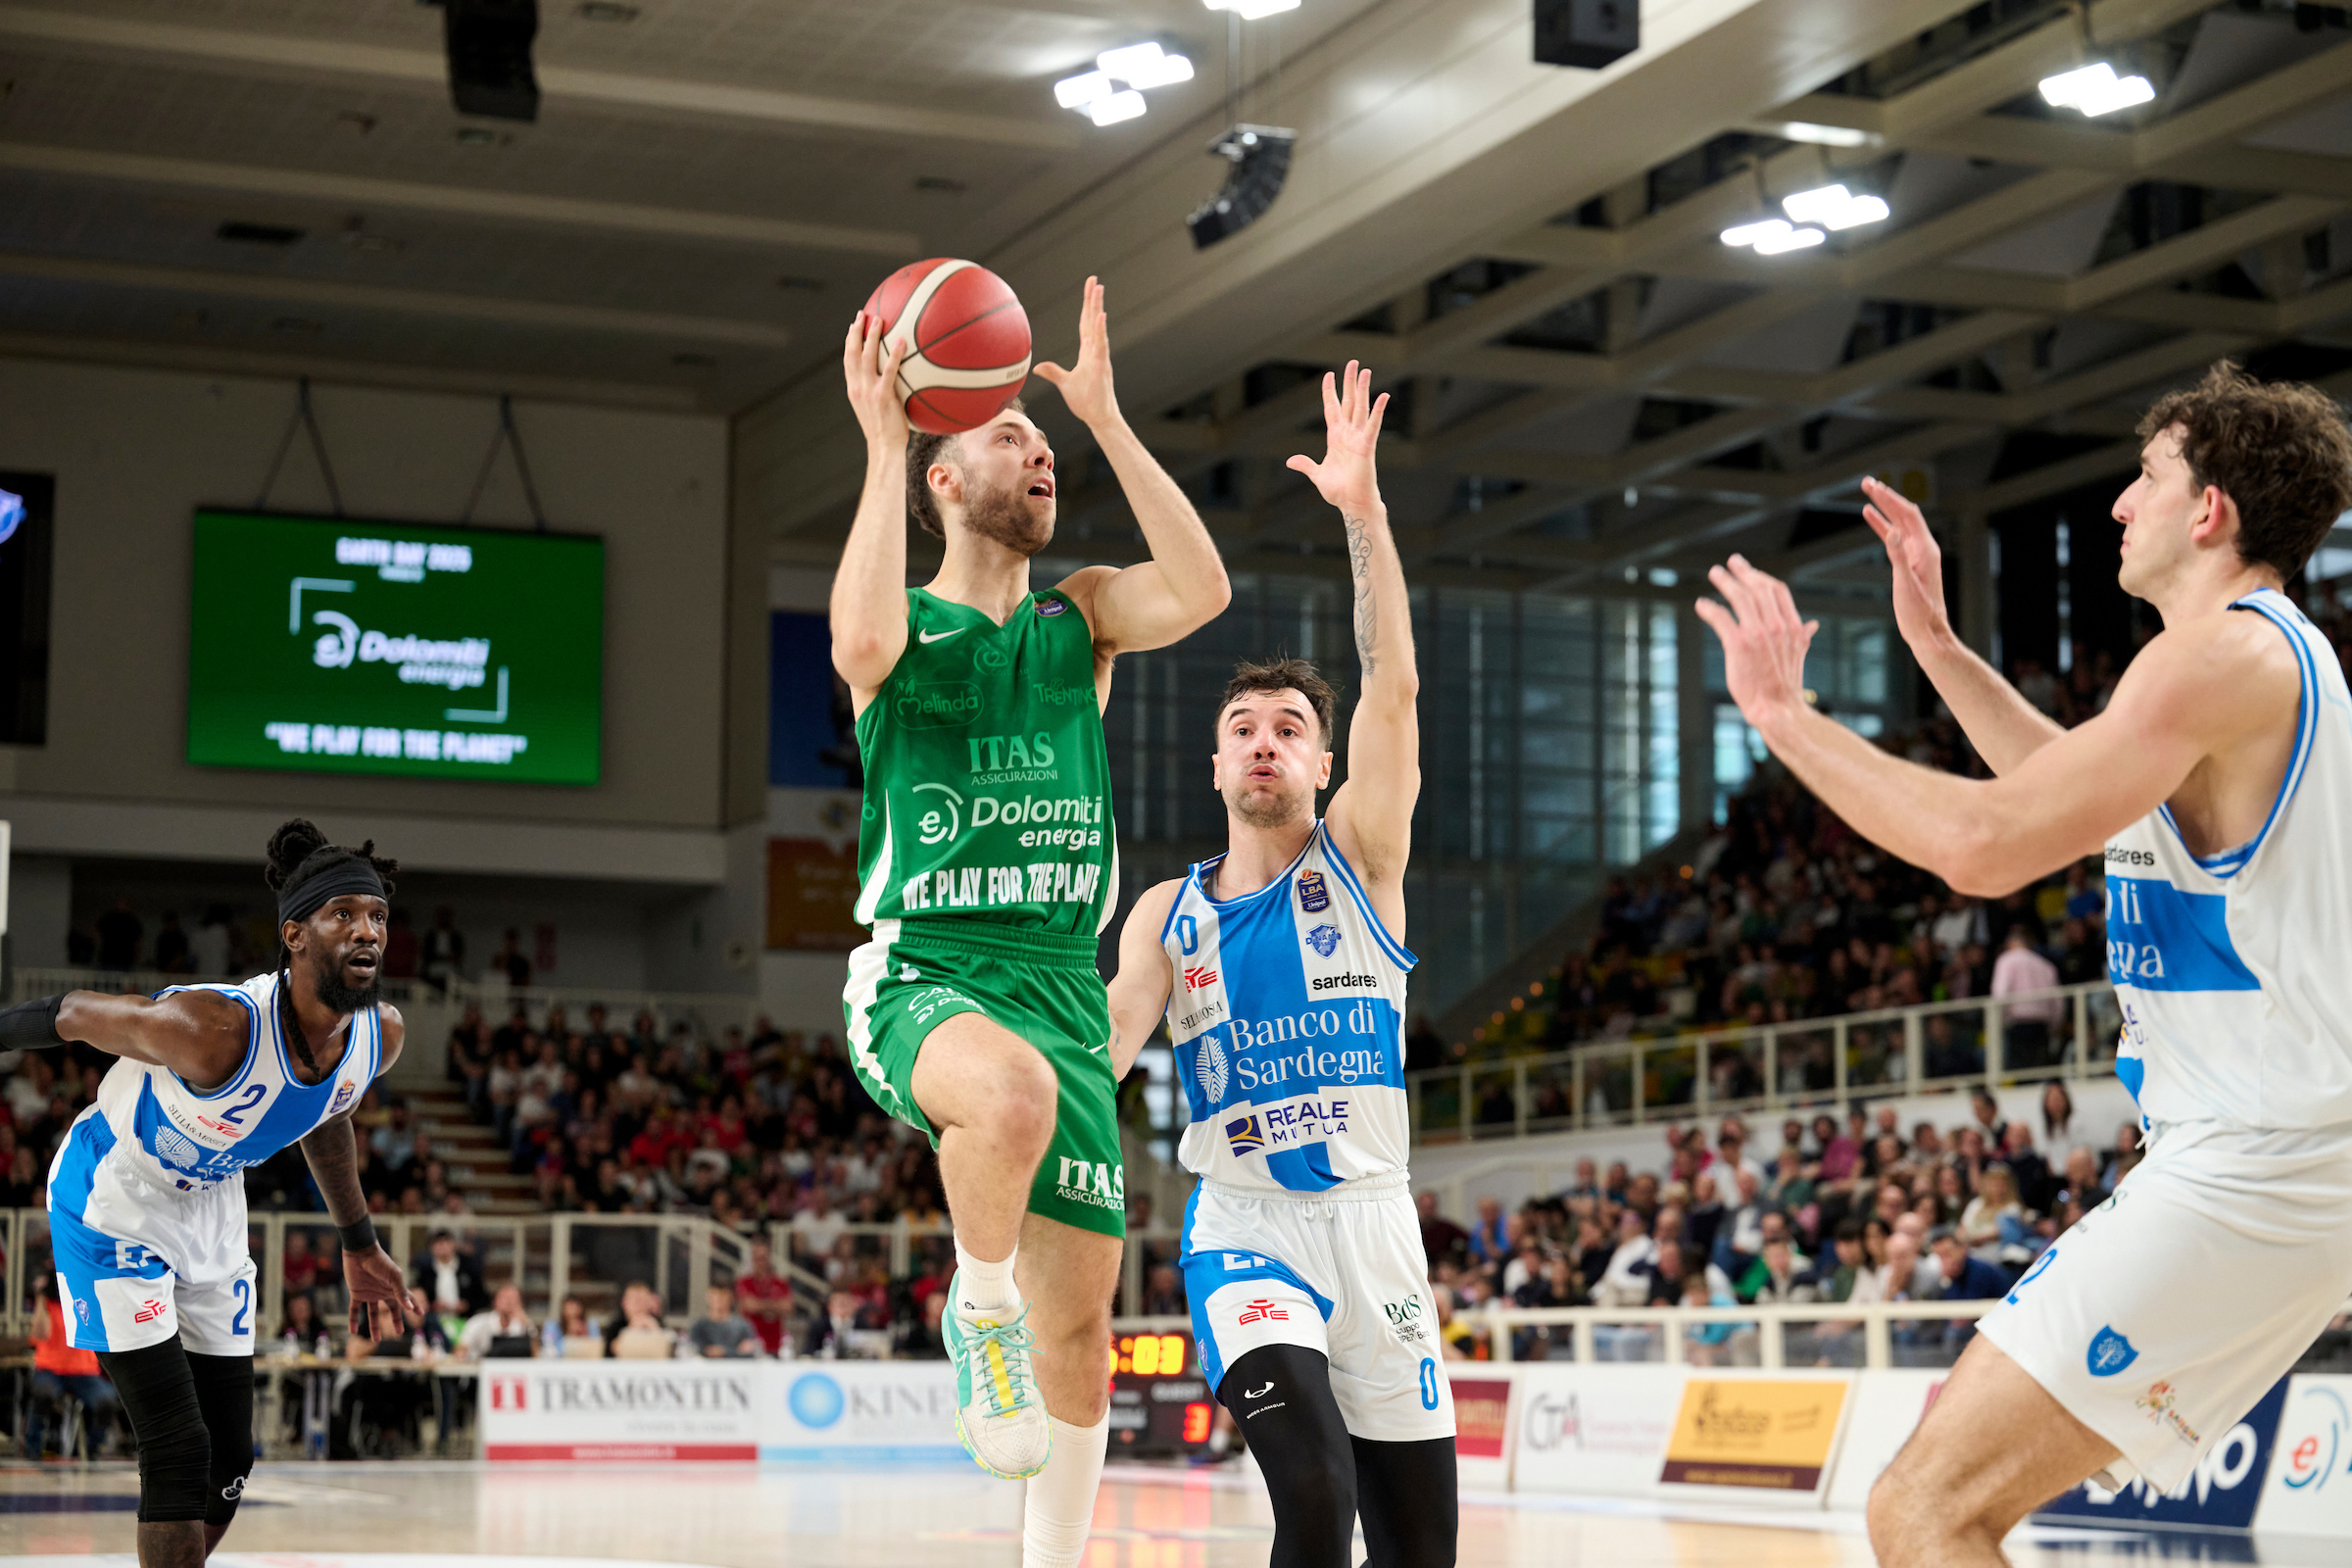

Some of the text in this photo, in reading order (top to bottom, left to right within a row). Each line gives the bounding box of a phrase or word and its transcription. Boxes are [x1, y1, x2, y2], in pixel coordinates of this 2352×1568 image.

[359, 630, 490, 666] Dolomiti
[312, 724, 361, 757] PLAY
[361, 727, 402, 759] FOR
[403, 729, 441, 760] THE
[966, 731, 1055, 774] ITAS
[971, 769, 1058, 786] ASSICURAZIONI
[970, 795, 1102, 827] Dolomiti
[1018, 827, 1102, 851] energia
[903, 870, 931, 910] WE
[936, 866, 982, 906] PLAY
[988, 865, 1023, 905] FOR
[1027, 862, 1054, 903] THE
[1301, 884, 1324, 897] LBA
[1177, 914, 1199, 956] 0
[1312, 971, 1377, 991] sardares
[1227, 1000, 1377, 1053] Banco di
[1236, 1046, 1386, 1090] Sardegna
[220, 1084, 268, 1124] 2
[1265, 1101, 1349, 1129] REALE
[1056, 1154, 1124, 1200] ITAS
[232, 1279, 250, 1336] 2
[1383, 1294, 1422, 1326] BdS
[538, 1374, 751, 1413] TRAMONTIN
[1420, 1357, 1439, 1411] 0
[1183, 1403, 1212, 1444] 3
